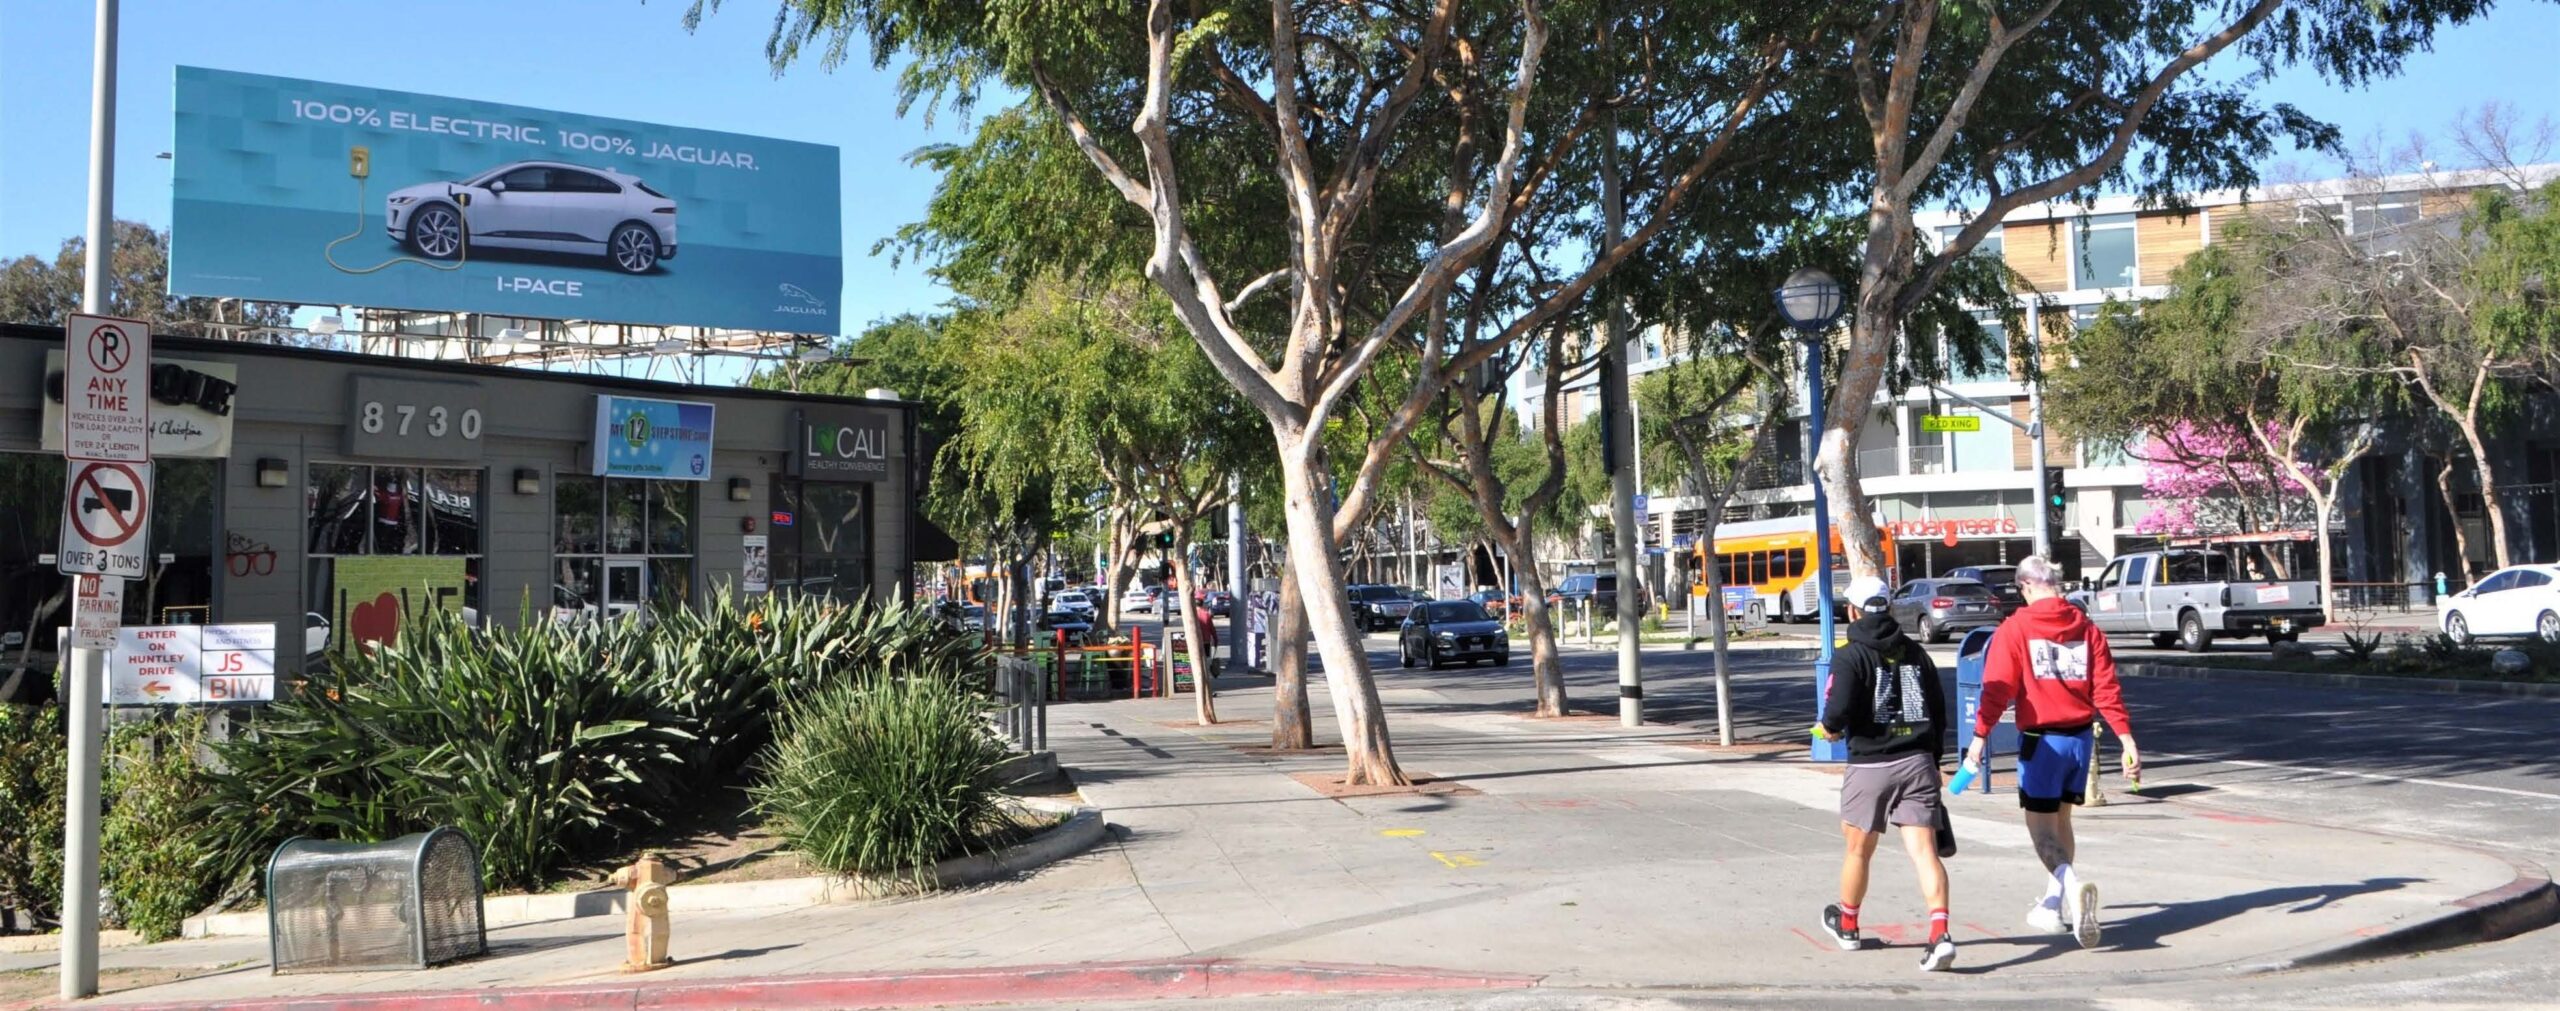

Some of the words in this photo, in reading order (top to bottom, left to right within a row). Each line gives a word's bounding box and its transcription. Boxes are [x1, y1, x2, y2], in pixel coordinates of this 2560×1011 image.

[292, 99, 381, 127] 100%
[390, 111, 546, 145] ELECTRIC.
[558, 130, 636, 156] 100%
[642, 142, 760, 170] JAGUAR.
[497, 276, 583, 296] I-PACE
[773, 305, 827, 316] JAGUAR
[88, 377, 128, 393] ANY
[87, 394, 129, 412] TIME
[72, 412, 106, 423] VEHICLES
[108, 414, 127, 423] OVER
[362, 401, 482, 440] 8730
[1930, 419, 1948, 429] PED
[1951, 419, 1972, 428] XING
[71, 422, 84, 431] TON
[87, 423, 106, 432] LOAD
[107, 424, 143, 434] CAPACITY
[630, 416, 646, 441] 12
[75, 440, 95, 449] OVER
[109, 443, 140, 452] LENGTH
[808, 460, 838, 470] HEALTHY
[839, 461, 886, 472] CONVENIENCE
[66, 550, 95, 566] OVER
[96, 549, 108, 572] 3
[112, 554, 140, 570] TONS
[80, 577, 97, 594] NO
[79, 599, 119, 614] PARKING
[137, 630, 177, 640] ENTER
[148, 642, 166, 651] ON
[128, 654, 185, 664] HUNTLEY
[217, 653, 244, 673] JS
[138, 666, 175, 676] DRIVE
[210, 678, 264, 699] BIW
